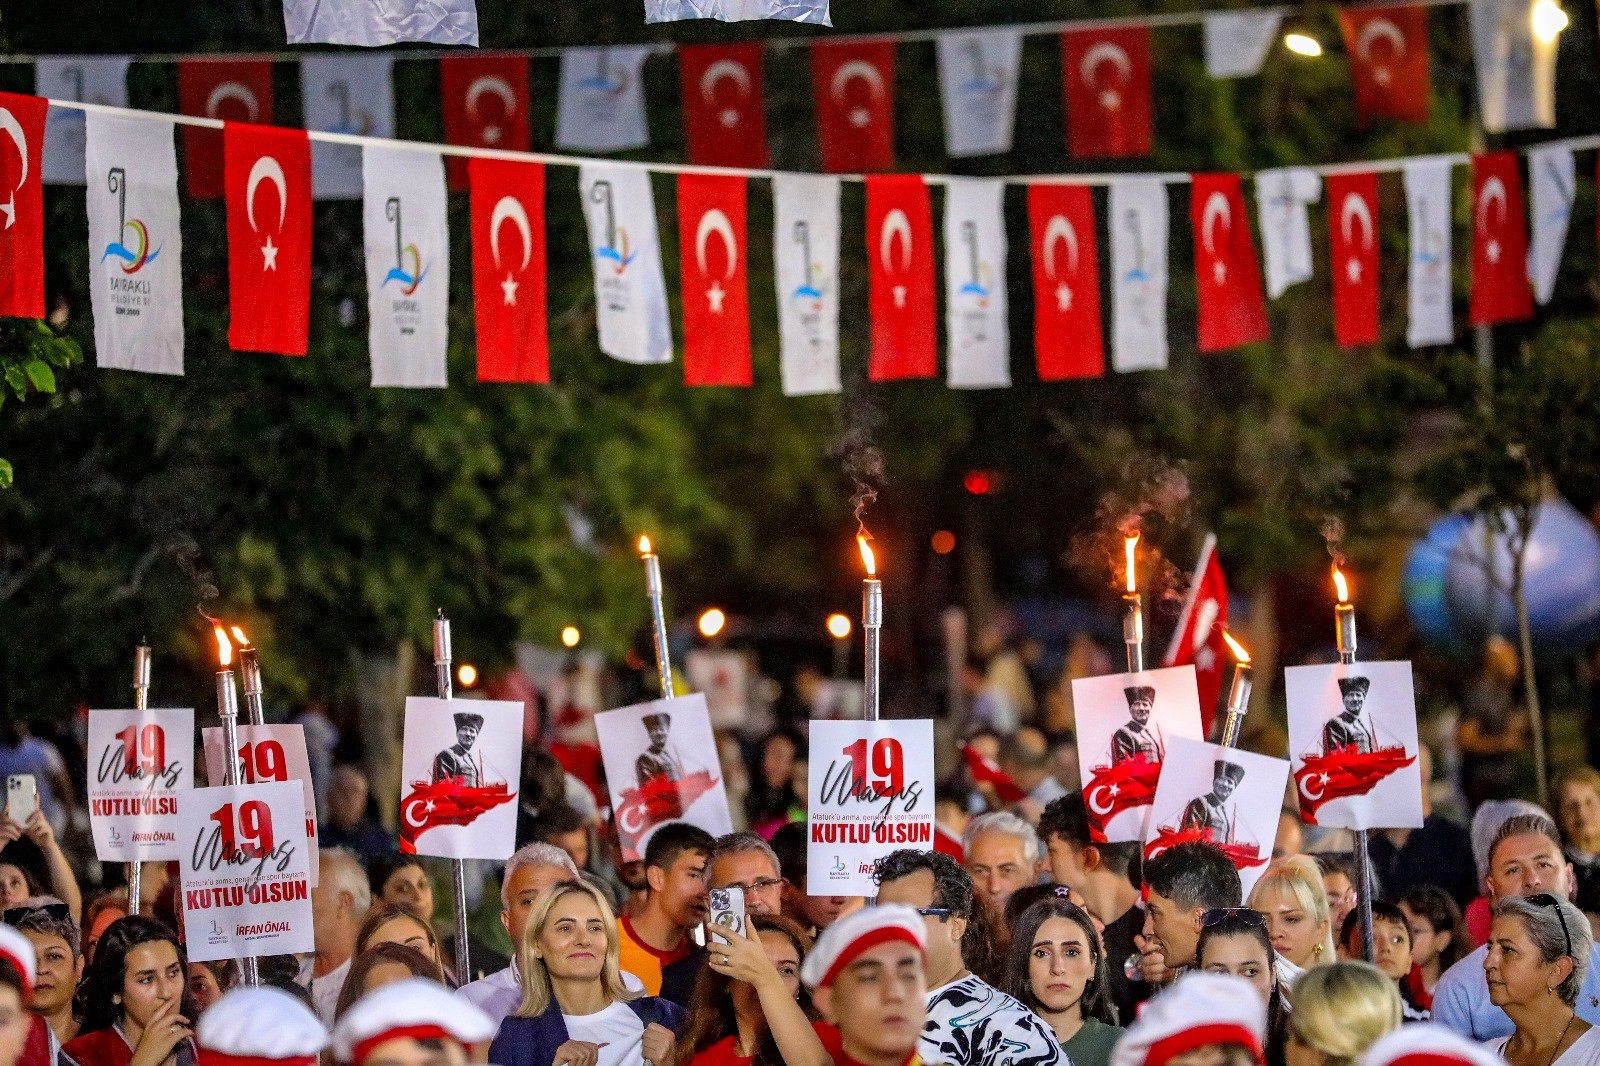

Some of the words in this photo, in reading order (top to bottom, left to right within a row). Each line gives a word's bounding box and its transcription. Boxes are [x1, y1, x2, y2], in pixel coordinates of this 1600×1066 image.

[115, 724, 165, 775] 19
[238, 740, 288, 784] 19
[842, 738, 905, 798] 19
[92, 798, 141, 817] KUTLU
[144, 797, 178, 816] OLSU
[820, 760, 923, 833] Mayıs
[210, 800, 274, 862] 19
[811, 822, 871, 844] KUTLU
[875, 822, 931, 844] OLSUN
[894, 814, 907, 822] spor
[153, 830, 176, 842] ÖNAL
[192, 826, 295, 895] Mayıs
[858, 861, 876, 874] İRF
[186, 886, 244, 910] KUTLU
[248, 880, 308, 905] OLSUN
[235, 922, 263, 937] İRFAN
[264, 920, 291, 933] ÖNAL
